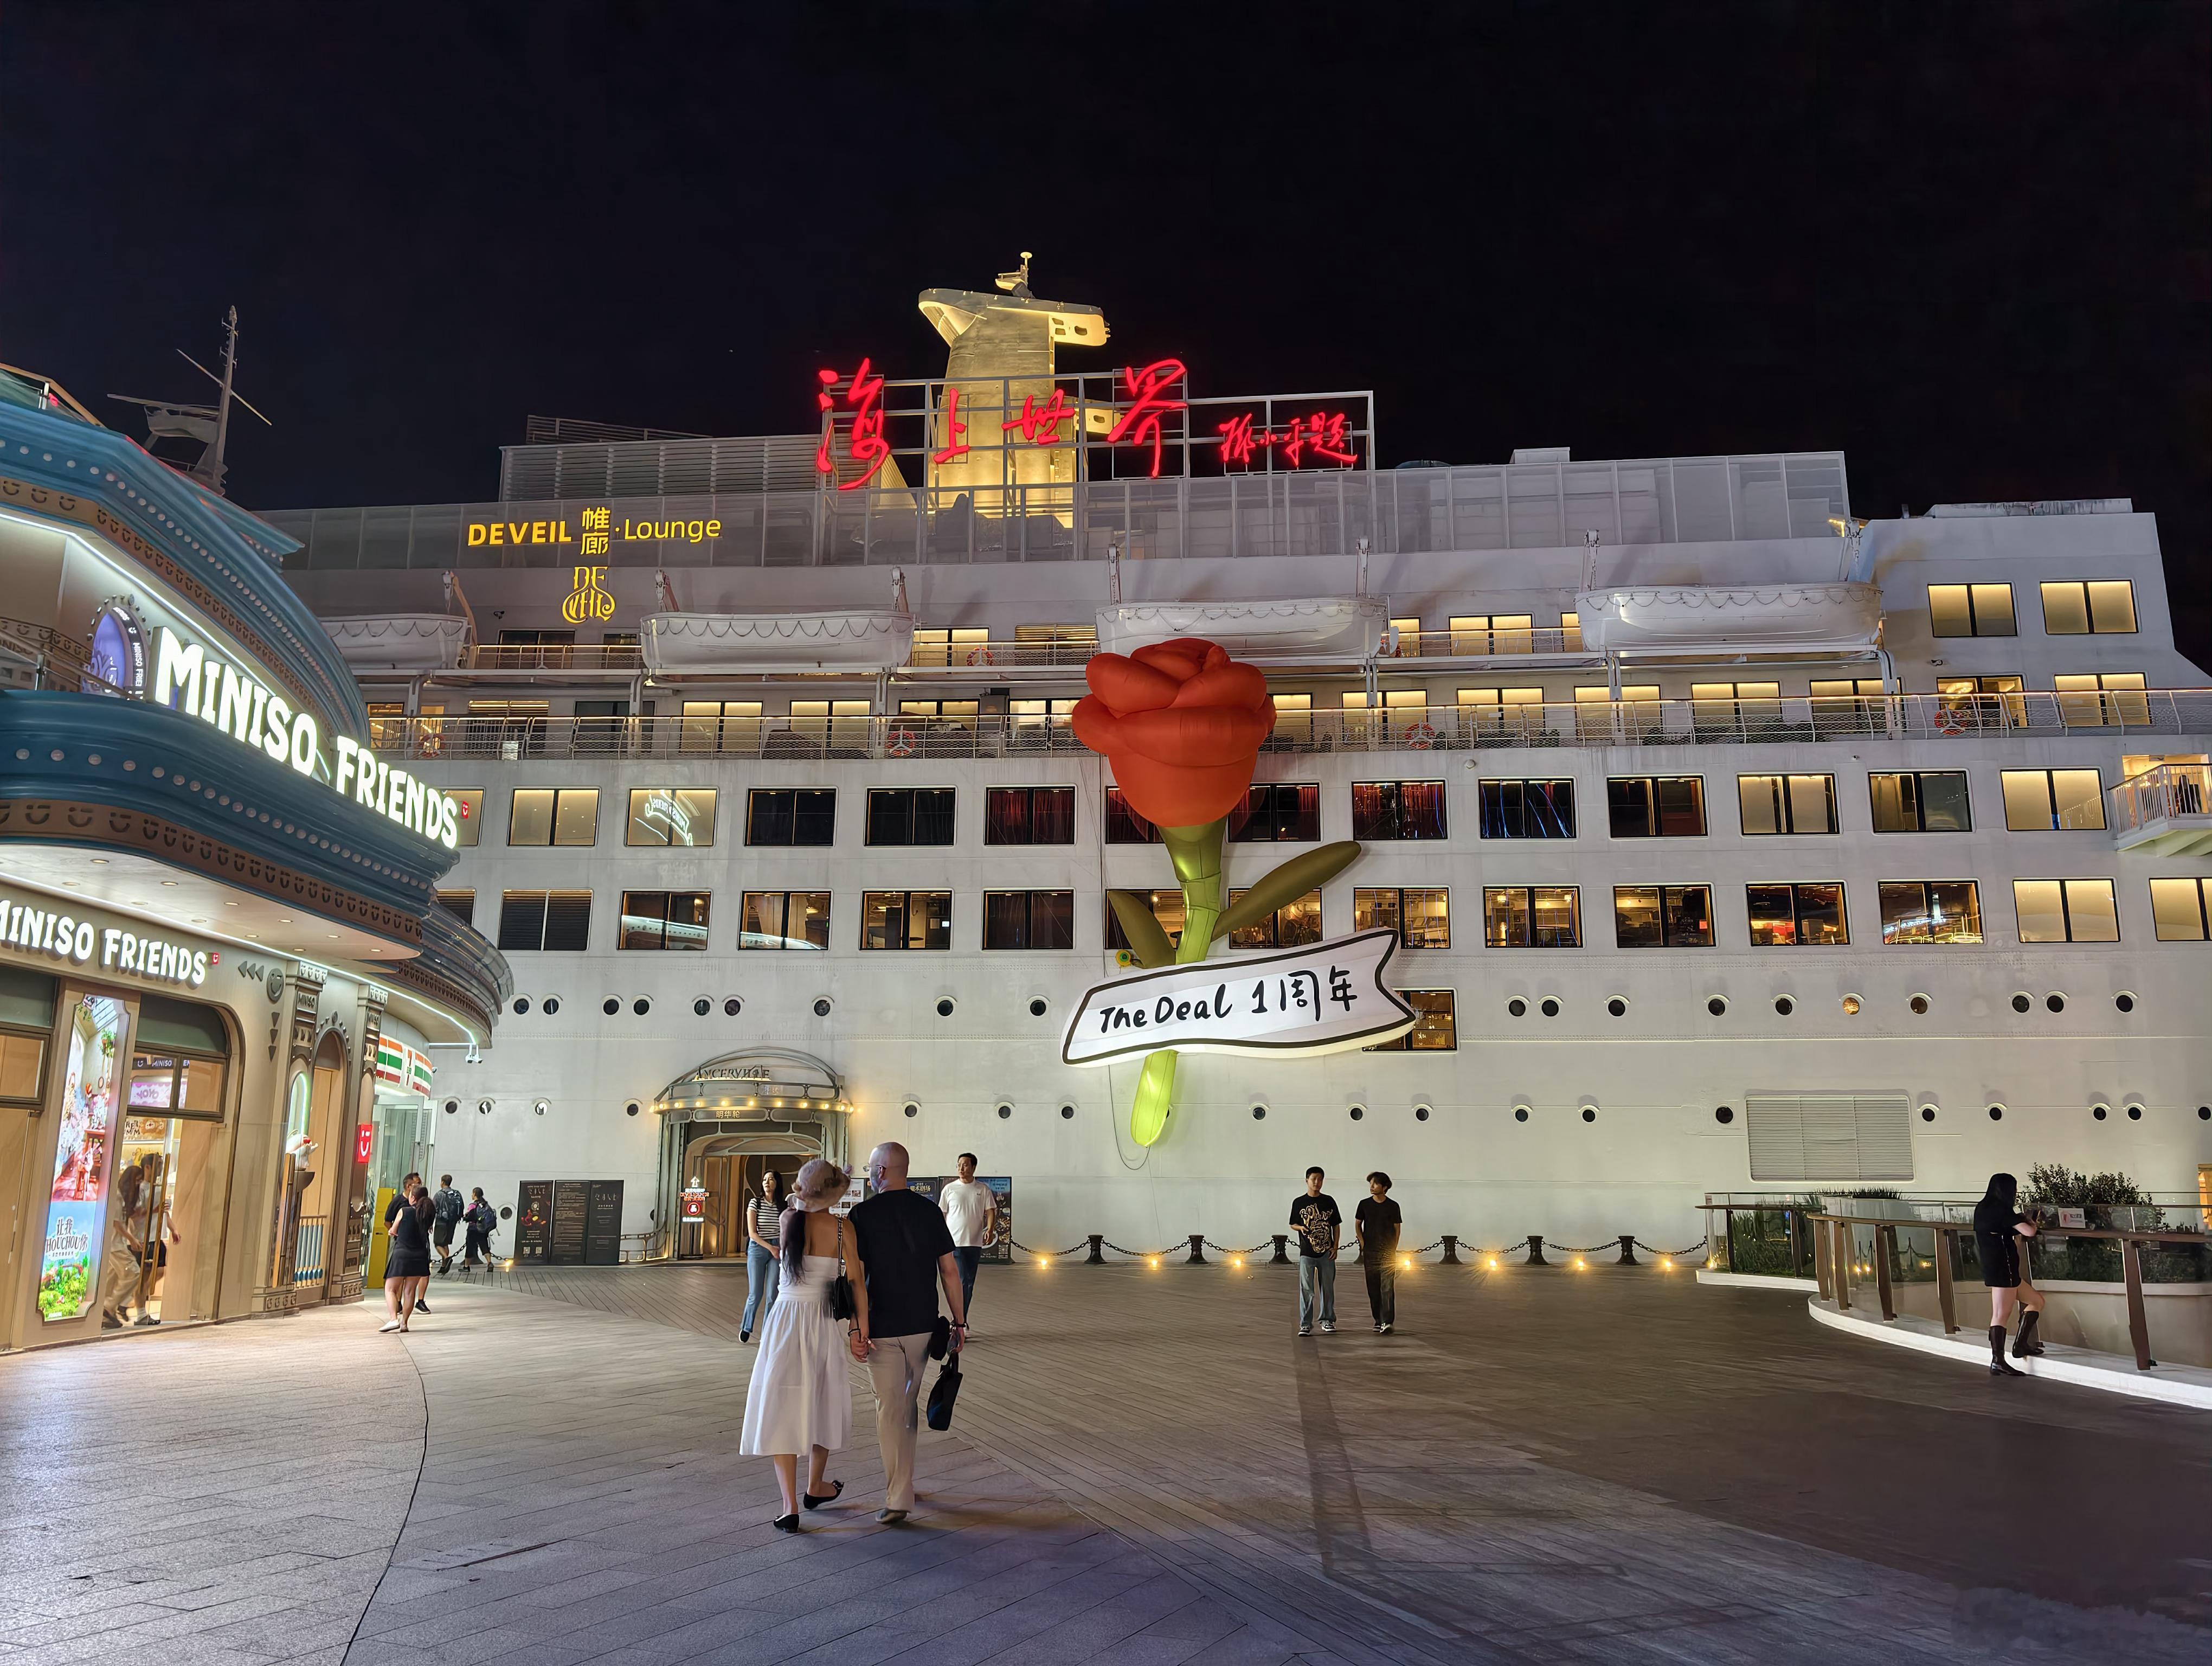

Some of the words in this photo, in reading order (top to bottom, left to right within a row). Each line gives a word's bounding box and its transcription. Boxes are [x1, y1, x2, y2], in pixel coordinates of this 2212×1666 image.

[817, 358, 1187, 490] 海上世界
[468, 521, 571, 546] DEVEIL
[581, 507, 610, 555] 帷廊
[155, 627, 317, 777] MINISO
[336, 736, 458, 849] FRIENDS
[104, 928, 207, 985] FRIENDS
[1099, 1007, 1148, 1034] The
[1154, 984, 1233, 1024] Deal
[152, 1059, 172, 1067] MINISO
[716, 1110, 741, 1119] 明华轮
